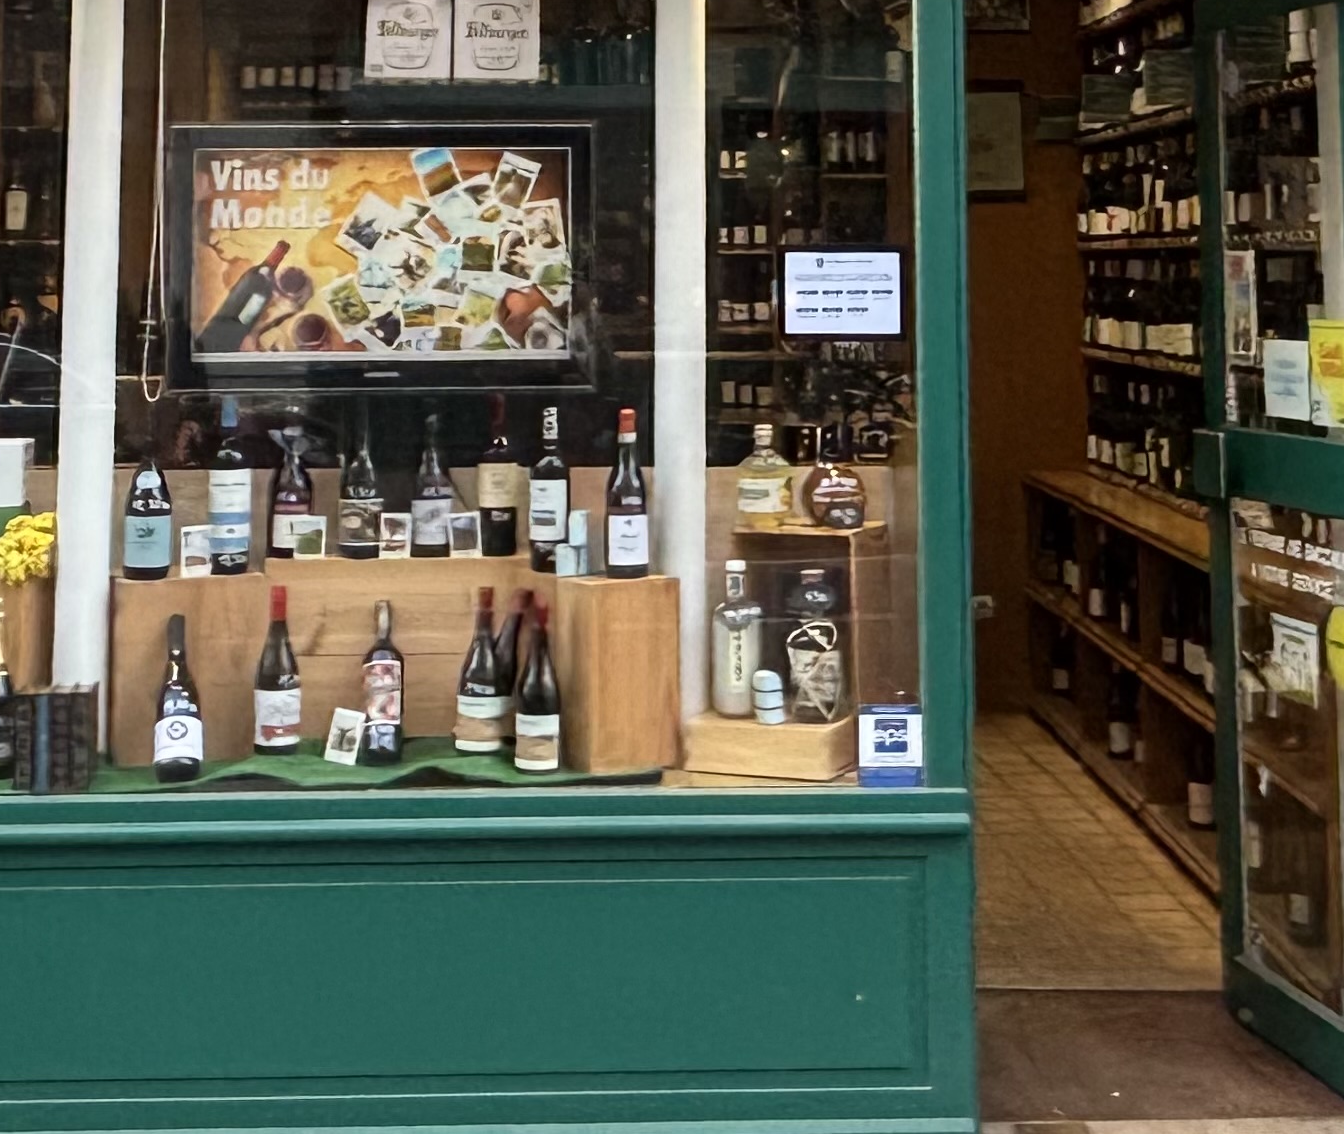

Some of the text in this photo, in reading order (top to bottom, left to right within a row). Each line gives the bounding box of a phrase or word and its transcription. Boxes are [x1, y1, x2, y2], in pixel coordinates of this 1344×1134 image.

[210, 159, 329, 191] Vins du
[210, 198, 332, 229] Monde
